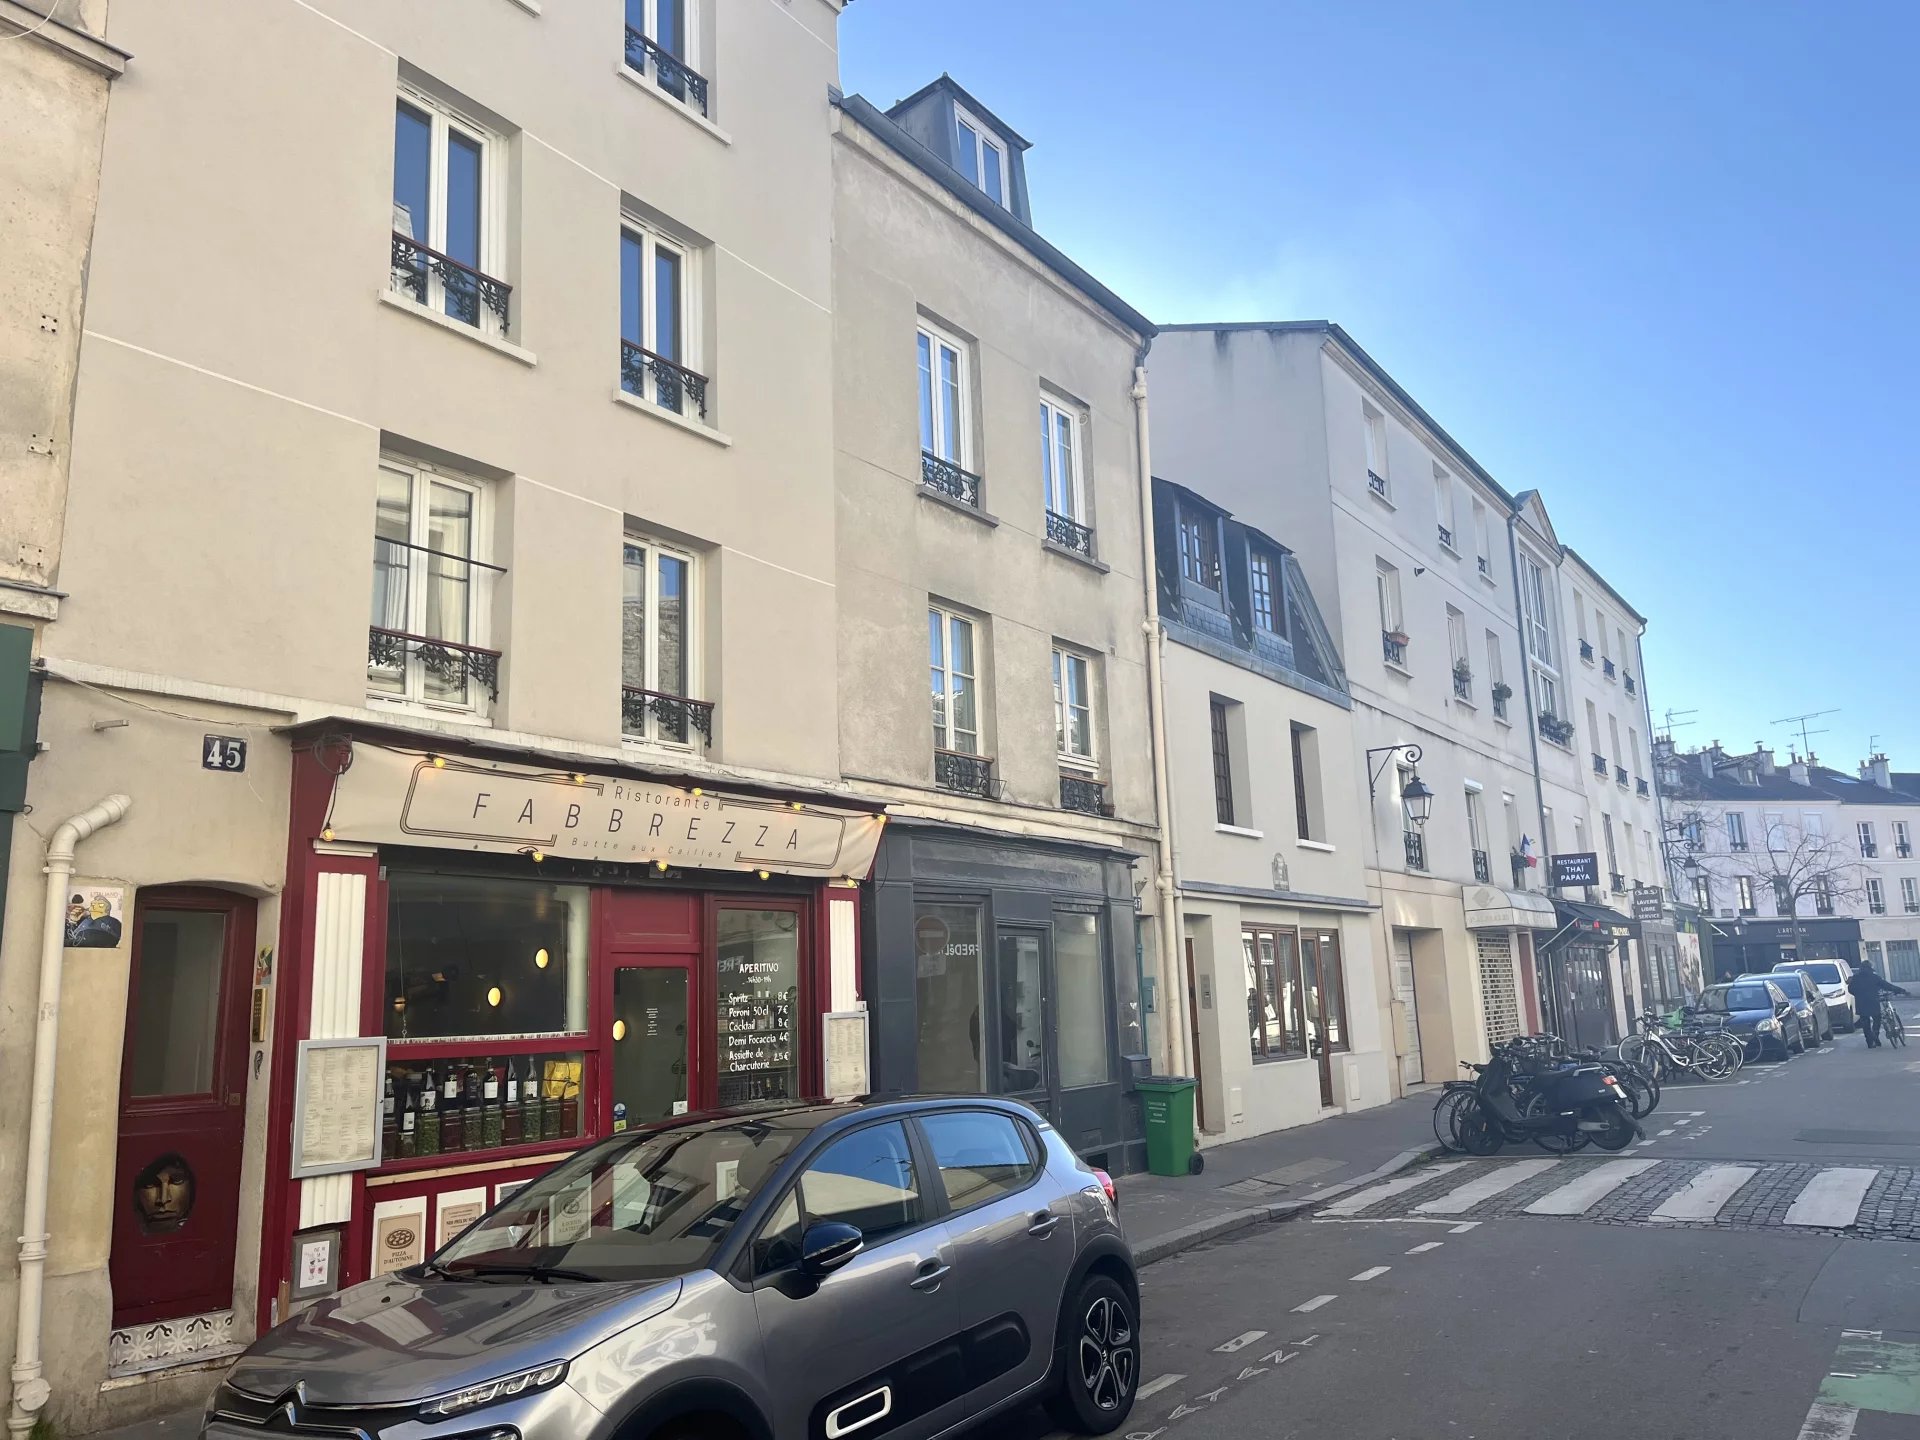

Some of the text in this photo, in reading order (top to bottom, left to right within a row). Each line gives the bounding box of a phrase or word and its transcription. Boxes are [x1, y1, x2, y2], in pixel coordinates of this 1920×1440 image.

[206, 740, 241, 769] 45
[614, 785, 710, 811] Ristorante
[472, 792, 798, 850] FABBREZZA
[571, 837, 722, 859] Butte aux Cailles
[1565, 864, 1585, 873] THAÏ
[1560, 873, 1591, 881] PAPAYA
[739, 962, 779, 973] APERITIVO
[728, 991, 789, 1006] Spritz 8€
[728, 1004, 789, 1017] Peroni 50cl 7€
[728, 1017, 789, 1032] Cocktail 8€
[728, 1032, 789, 1047] Demi Focaccia 4€
[728, 1047, 789, 1062] Assiette de 25€
[729, 1060, 770, 1072] Charcuterie
[383, 1255, 413, 1264] D'AUTOMNE
[1125, 1334, 1320, 1440] PAYANT
